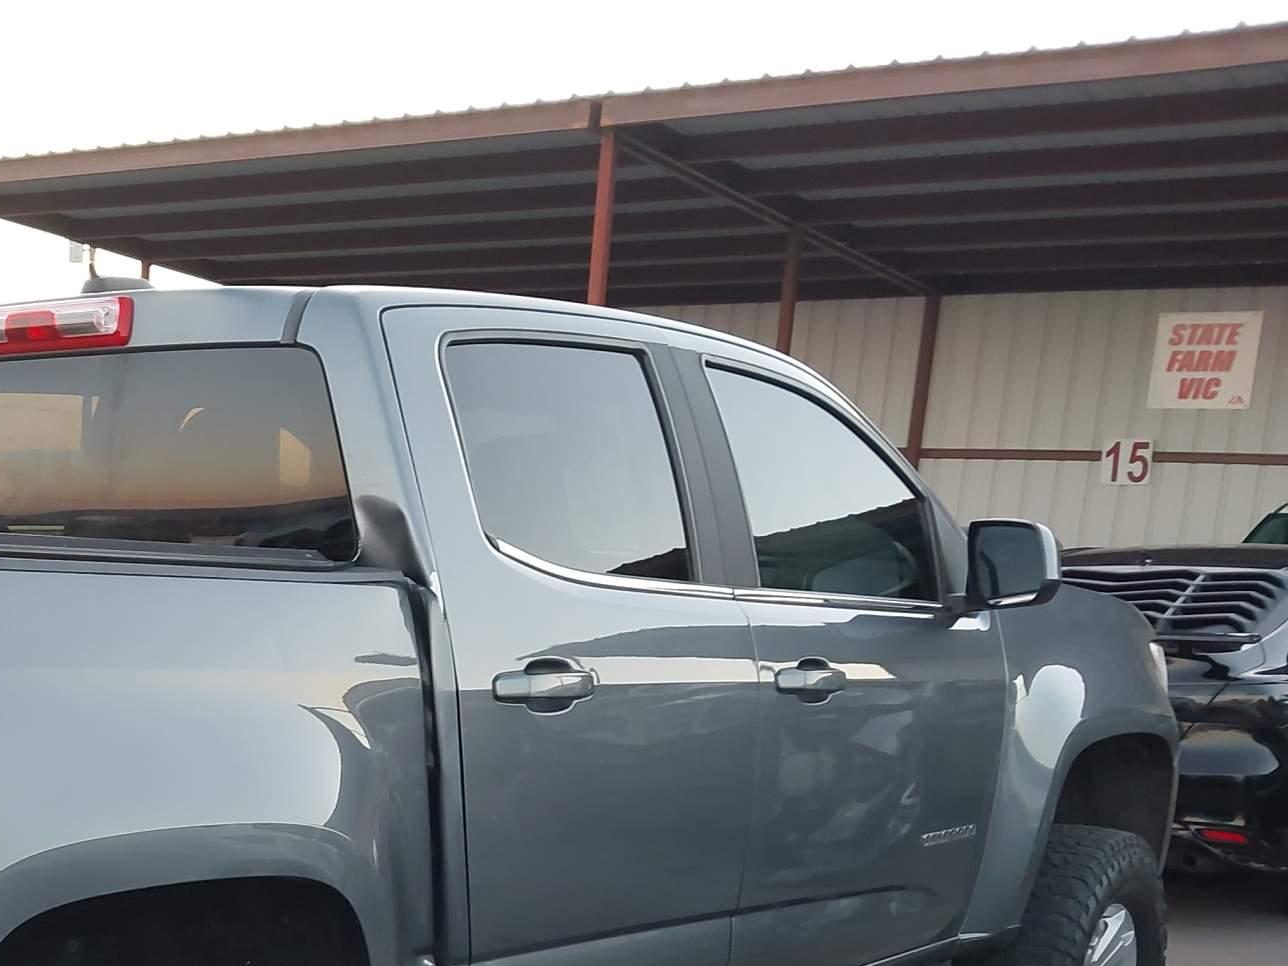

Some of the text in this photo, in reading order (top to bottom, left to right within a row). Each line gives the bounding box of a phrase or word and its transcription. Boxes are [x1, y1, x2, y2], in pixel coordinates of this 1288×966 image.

[1168, 323, 1244, 346] STATE
[1165, 350, 1237, 372] FARM
[1177, 377, 1221, 400] VIC
[1105, 441, 1150, 483] 15
